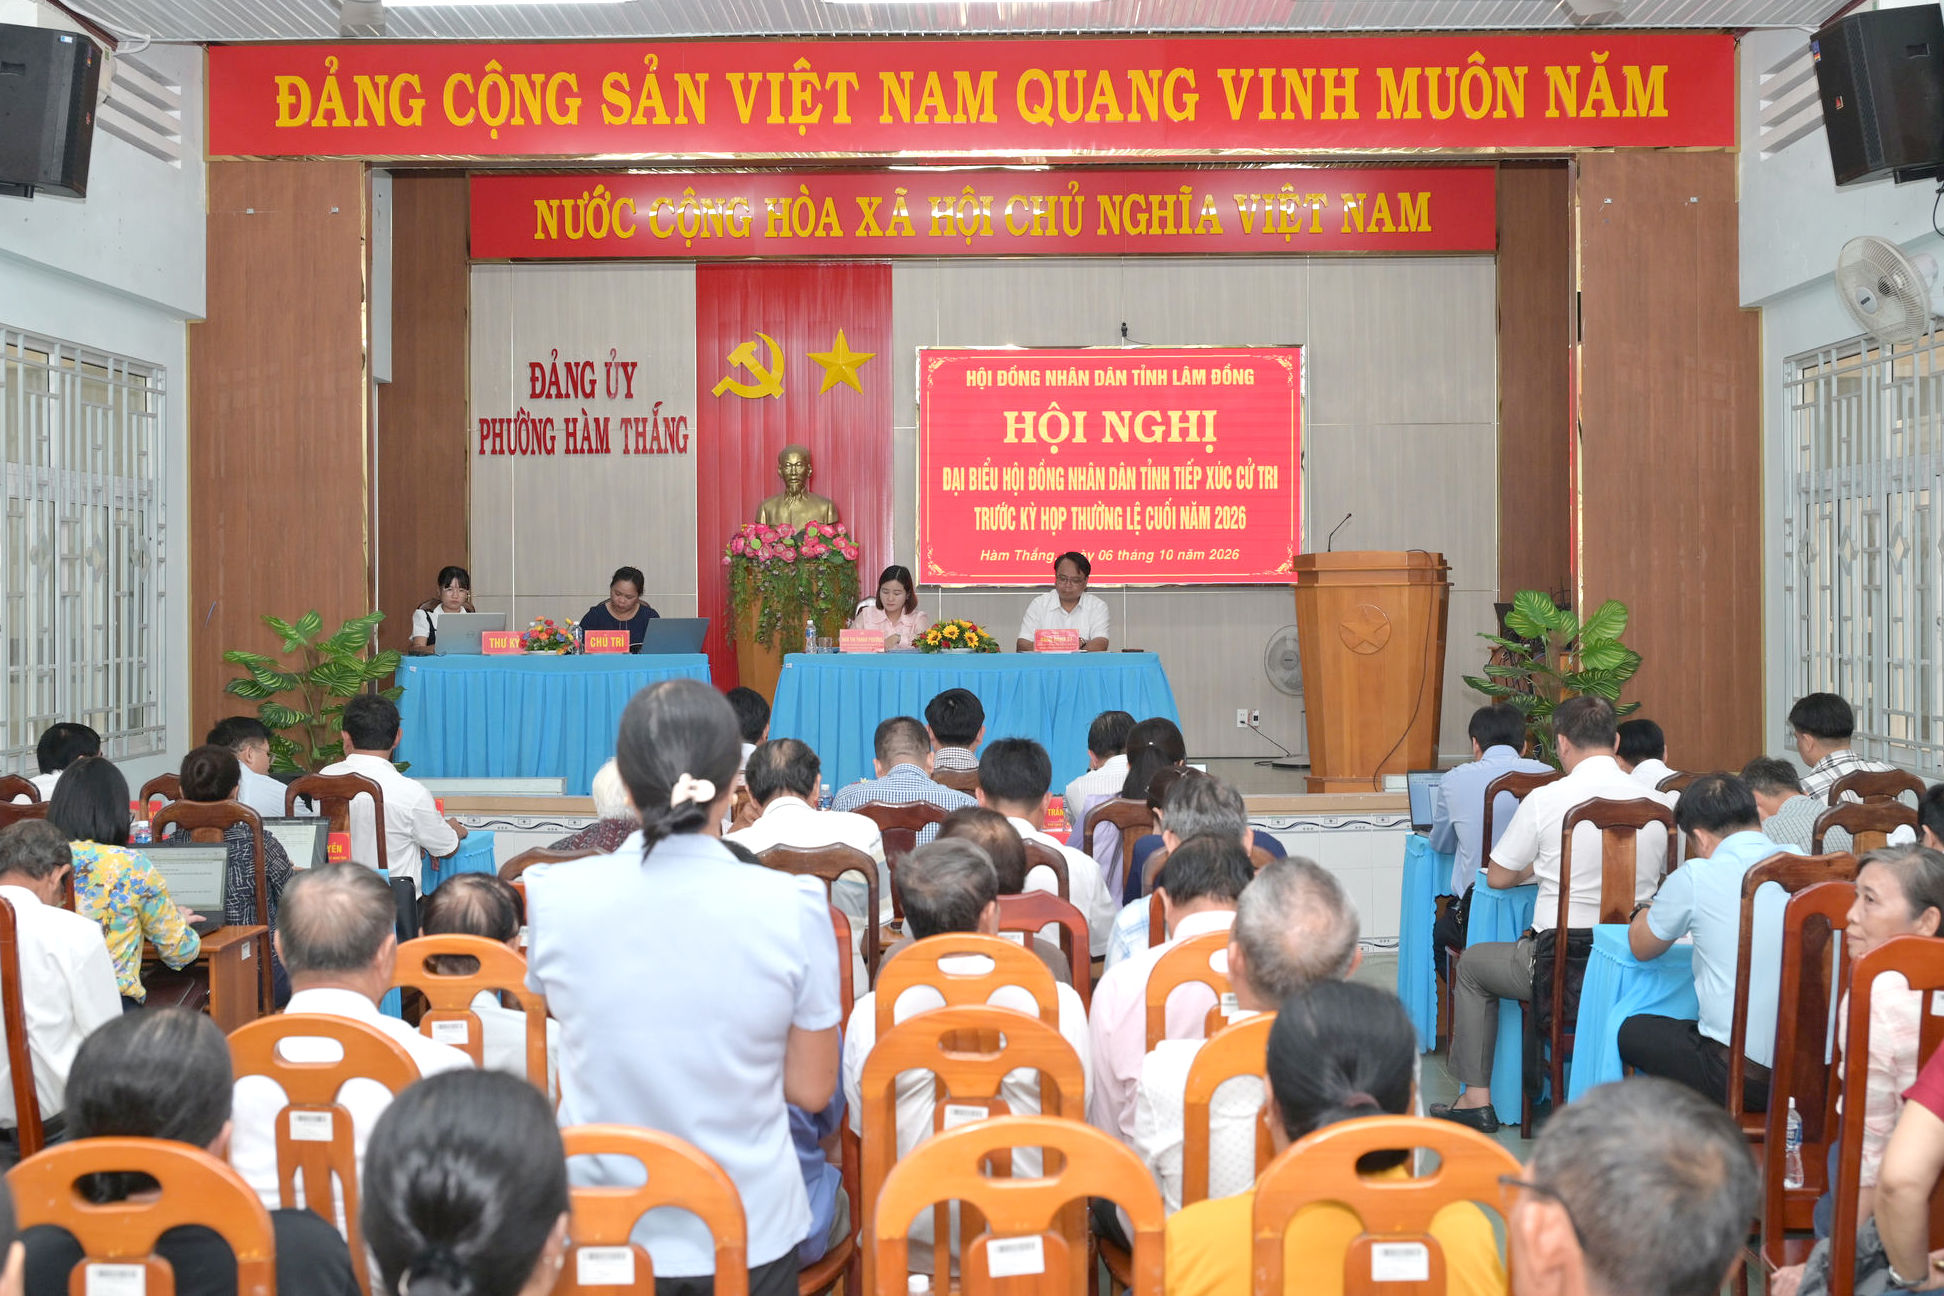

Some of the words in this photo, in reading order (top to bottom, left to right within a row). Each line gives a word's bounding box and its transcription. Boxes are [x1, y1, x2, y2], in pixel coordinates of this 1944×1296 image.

[275, 55, 426, 128] ĐẢNG
[442, 58, 583, 140] CỘNG
[600, 53, 709, 126] SẢN
[726, 56, 859, 136] VIỆT
[878, 70, 998, 124] NAM
[1016, 67, 1200, 128] QUANG
[1217, 67, 1360, 121] VINH
[1376, 51, 1529, 120] MUÔN
[1544, 50, 1669, 118] NĂM
[534, 184, 637, 240] NƯỚC
[648, 186, 754, 248] CỘNG
[764, 184, 844, 238] HÒA
[855, 186, 917, 237] XÃ
[928, 184, 995, 246] HỘI
[1004, 180, 1085, 237] CHỦ
[1097, 184, 1225, 236] NGHĨA
[1233, 181, 1330, 243] VIỆT
[1341, 191, 1432, 233] NAM
[528, 348, 598, 400] ĐẢNG
[604, 348, 638, 400] ỦY
[966, 366, 993, 390] HỘI
[996, 364, 1041, 387] ĐỒNG
[1045, 366, 1090, 387] NHÂN
[1094, 366, 1128, 387] DÂN
[1131, 364, 1168, 386] TỈNH
[1172, 365, 1207, 386] LÂM
[1210, 363, 1255, 386] ĐỒNG
[478, 406, 557, 456] PHƯỜNG
[564, 407, 611, 455] HÀM
[620, 400, 690, 455] THẮNG
[1003, 401, 1088, 455] HỘI
[1101, 409, 1218, 454] NGHỊ
[942, 466, 965, 497] ĐẠI
[968, 456, 999, 492] BIỂU
[1002, 461, 1025, 497] HỘI
[1027, 458, 1065, 492] ĐỒNG
[1068, 461, 1106, 491] NHÂN
[1109, 461, 1137, 491] DÂN
[1140, 457, 1170, 491] TỈNH
[1173, 457, 1203, 491] TIẾP
[1206, 460, 1233, 490] XÚC
[1236, 458, 1255, 490] CỬ
[1257, 465, 1279, 489] TRI
[973, 501, 1017, 531] TRƯỚC
[1020, 501, 1038, 531] KỲ
[1040, 506, 1068, 536] HỌP
[1071, 500, 1123, 531] THƯỜNG
[1126, 500, 1142, 536] LỆ
[1145, 497, 1177, 531] CUỐI
[1180, 500, 1211, 530] NĂM
[1214, 505, 1247, 530] 2026
[980, 548, 1010, 561] Hàm
[1098, 549, 1114, 561] 06
[1117, 548, 1155, 564] tháng
[1159, 549, 1174, 561] 10
[1177, 548, 1205, 561] năm
[1208, 548, 1241, 561] 2026
[489, 635, 508, 649] THƯ
[589, 634, 609, 648] CHỦ
